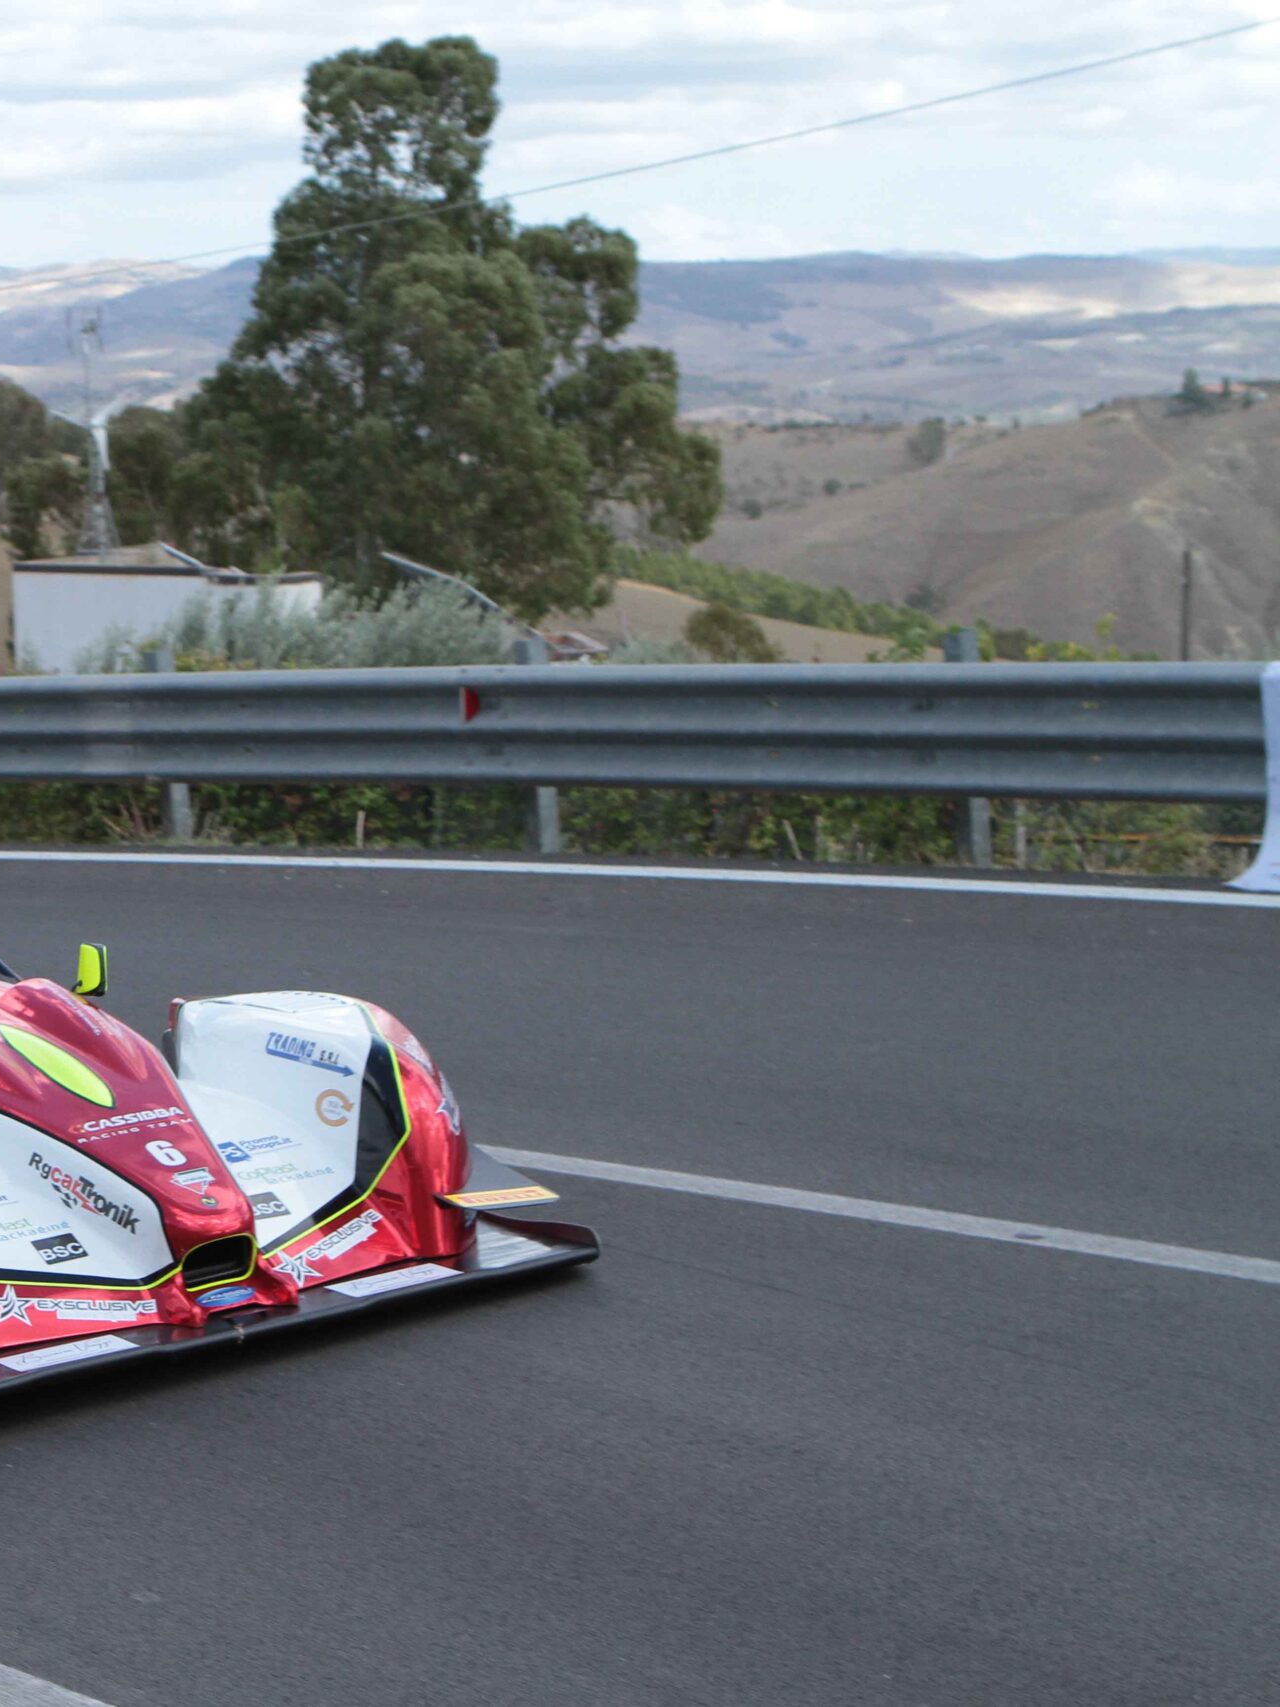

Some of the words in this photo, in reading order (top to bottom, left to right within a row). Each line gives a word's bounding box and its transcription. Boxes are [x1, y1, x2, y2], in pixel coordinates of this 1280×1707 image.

[265, 1031, 317, 1058] TRADING
[77, 1126, 141, 1145] RACING
[146, 1117, 194, 1130] TEAM
[83, 1106, 185, 1133] CASSIBBA
[144, 1139, 188, 1167] 6
[237, 1135, 279, 1147] Promo
[252, 1201, 285, 1217] SC
[305, 1209, 380, 1259] EXSCLUSIVE
[40, 1241, 84, 1262] BSC
[36, 1300, 156, 1312] EXSCLUSIVE
